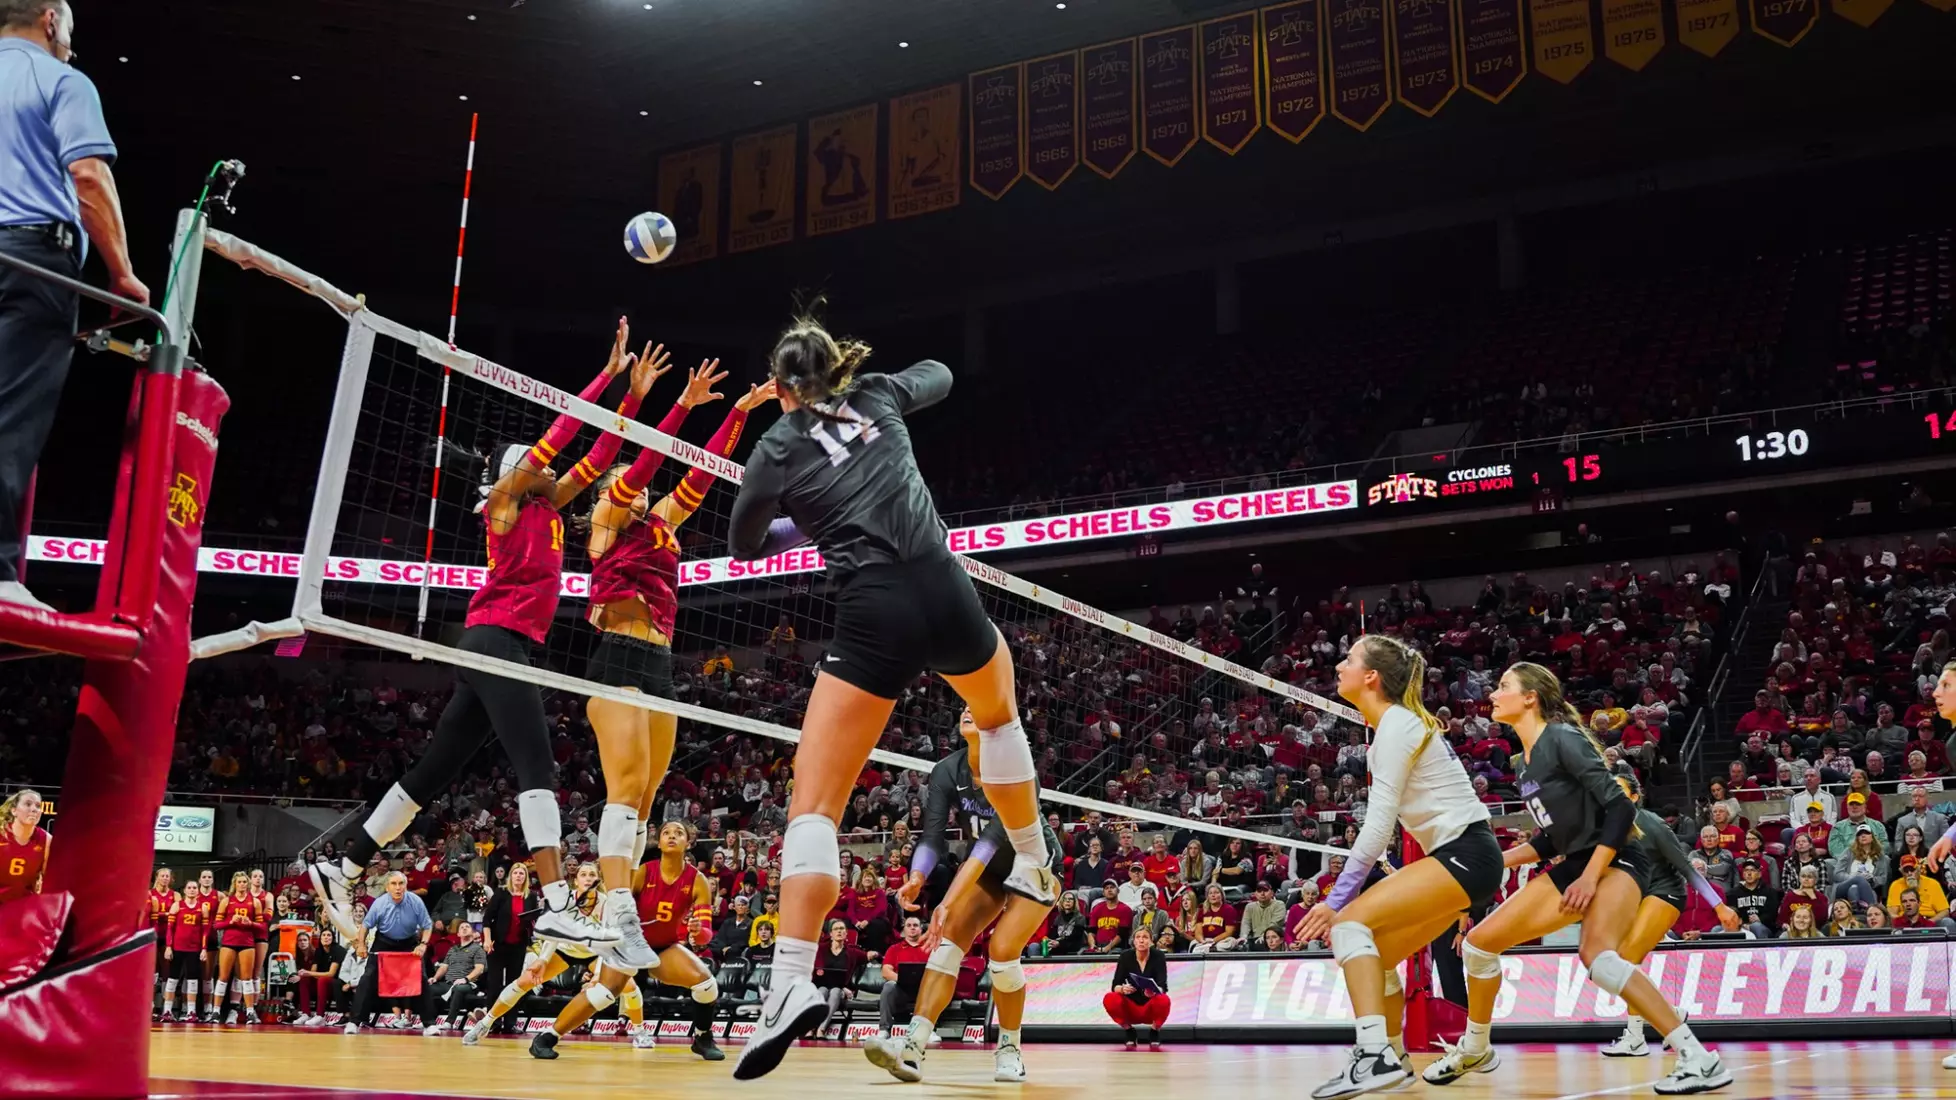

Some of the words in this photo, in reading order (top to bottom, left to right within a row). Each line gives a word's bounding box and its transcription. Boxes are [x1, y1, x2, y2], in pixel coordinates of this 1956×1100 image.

[1333, 7, 1380, 28] STATE
[1687, 12, 1730, 33] 1977
[1269, 20, 1316, 42] STATE
[1207, 34, 1251, 55] STATE
[1544, 41, 1585, 60] 1975
[1147, 47, 1190, 68] STATE
[1475, 54, 1514, 75] 1974
[1087, 61, 1130, 82] STATE
[1272, 70, 1316, 83] NATIONAL
[1408, 69, 1448, 89] 1973
[1031, 73, 1073, 94] STATE
[1341, 84, 1380, 103] 1973
[1276, 97, 1315, 115] 1972
[1215, 109, 1248, 126] 1971
[1153, 122, 1188, 139] 1970
[474, 357, 518, 391] IOWA
[519, 376, 571, 411] STATE
[670, 438, 705, 465] IOWA
[1736, 429, 1810, 461] 1:30
[1448, 463, 1513, 482] CYCLONES
[1532, 471, 1540, 485] 1
[1562, 454, 1601, 482] 15
[1367, 477, 1438, 506] STATE
[1440, 480, 1477, 496] SETS
[1479, 476, 1514, 492] WON
[1192, 483, 1352, 523] SCHEELS
[1024, 506, 1172, 543] SCHEELS
[980, 563, 1008, 587] STATE
[1061, 596, 1082, 614] IOWA
[1081, 603, 1105, 624] STATE
[180, 817, 206, 828] Ford
[1525, 796, 1554, 829] 12
[9, 858, 26, 876] 6
[183, 913, 196, 925] 21
[655, 901, 673, 922] 5
[661, 1022, 690, 1034] HyVee
